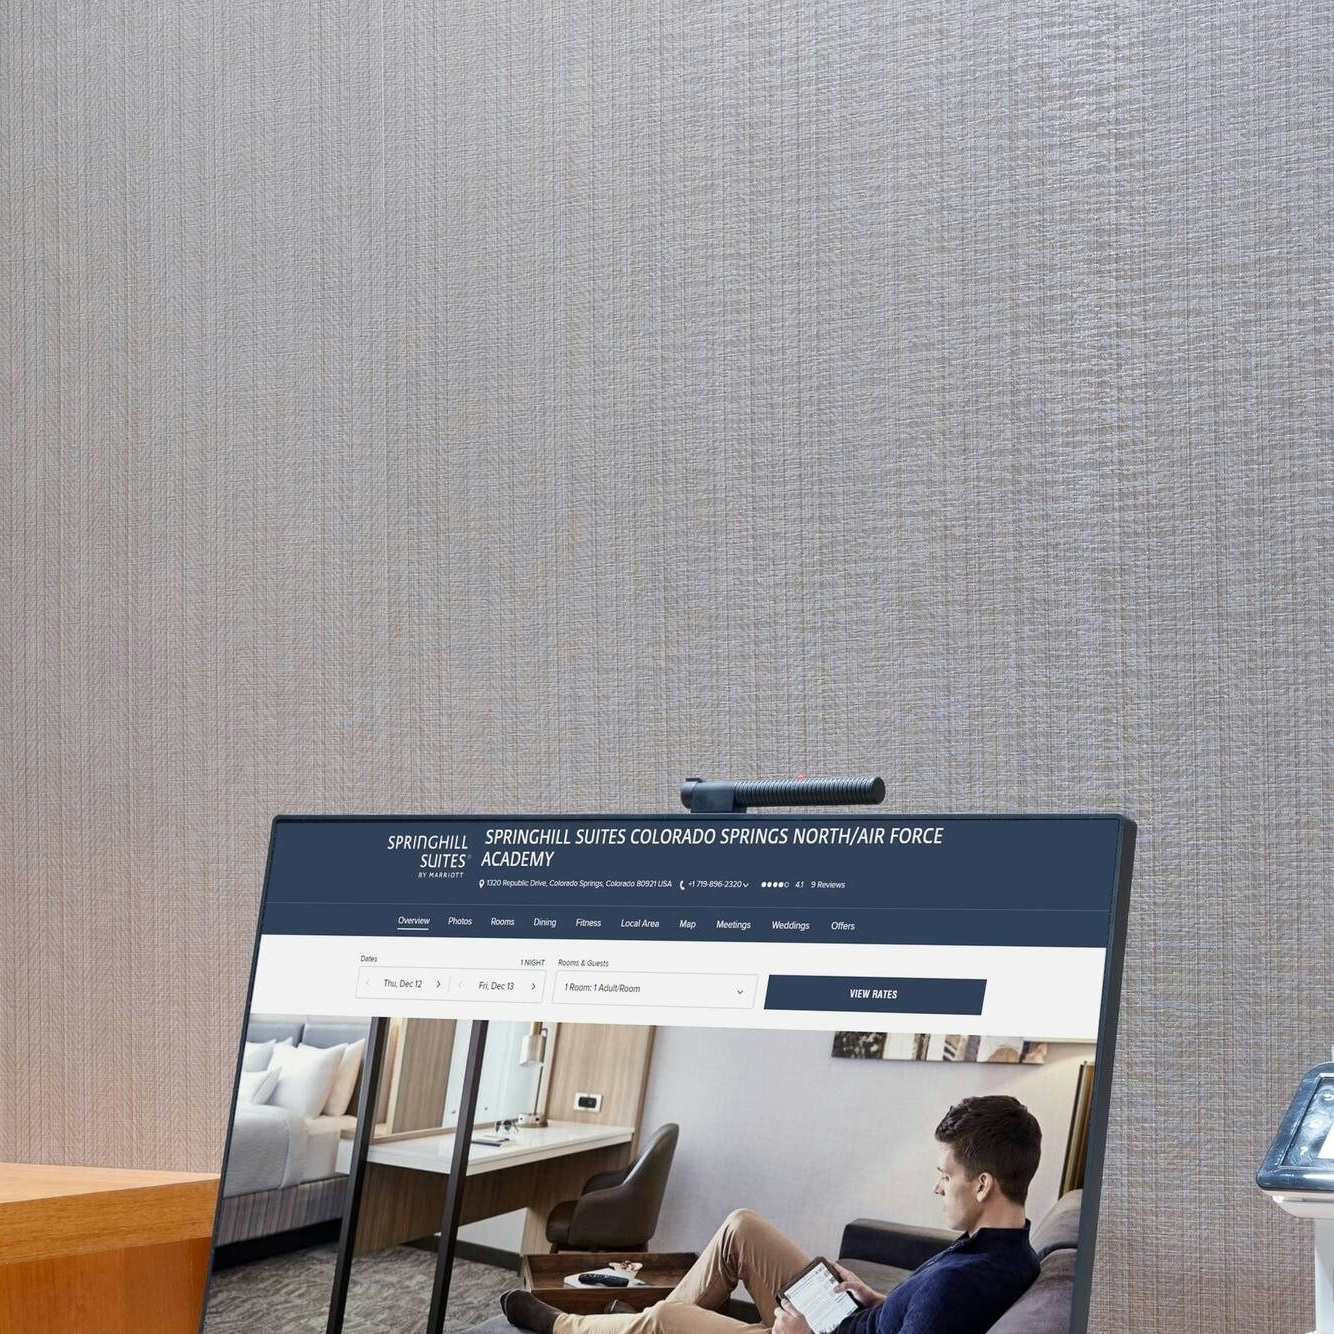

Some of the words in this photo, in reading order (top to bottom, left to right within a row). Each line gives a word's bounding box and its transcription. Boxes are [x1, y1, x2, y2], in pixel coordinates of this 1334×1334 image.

[484, 829, 571, 845] SPRINGHILL
[575, 829, 626, 845] SUITES
[630, 828, 716, 845] COLORADO
[720, 828, 788, 845] SPRINGS
[793, 827, 884, 846] NORTH/AIR
[889, 827, 944, 844] FORCE
[387, 835, 468, 849] SPRINGHILL
[420, 854, 467, 868] SUITES
[481, 851, 555, 867] ACADEMY
[502, 879, 529, 888] Republic
[530, 879, 548, 888] Drive,
[549, 879, 578, 887] Colorado
[579, 879, 604, 889] Springs,
[606, 879, 635, 887] Colorado
[817, 881, 846, 889] Reviews
[398, 916, 430, 925] Overview
[448, 916, 473, 925] Photos
[491, 917, 515, 926] Rooms
[533, 917, 557, 928] Dining
[575, 918, 602, 927] Fitness
[621, 918, 640, 928] Local
[641, 918, 660, 928] Area
[679, 920, 696, 930] Map
[716, 920, 751, 930] Meetings
[772, 920, 810, 931] Weddings
[831, 920, 855, 930] Offers
[558, 959, 579, 967] Rooms
[587, 959, 609, 967] Guests
[384, 979, 398, 989] Thu,
[399, 979, 414, 988] Dec
[415, 980, 422, 988] 12
[479, 981, 489, 991] Fri,
[491, 982, 505, 990] Dec
[507, 982, 515, 990] 13
[598, 983, 641, 993] Adult/Room
[849, 989, 870, 999] VIEW
[872, 989, 898, 1000] RATES
